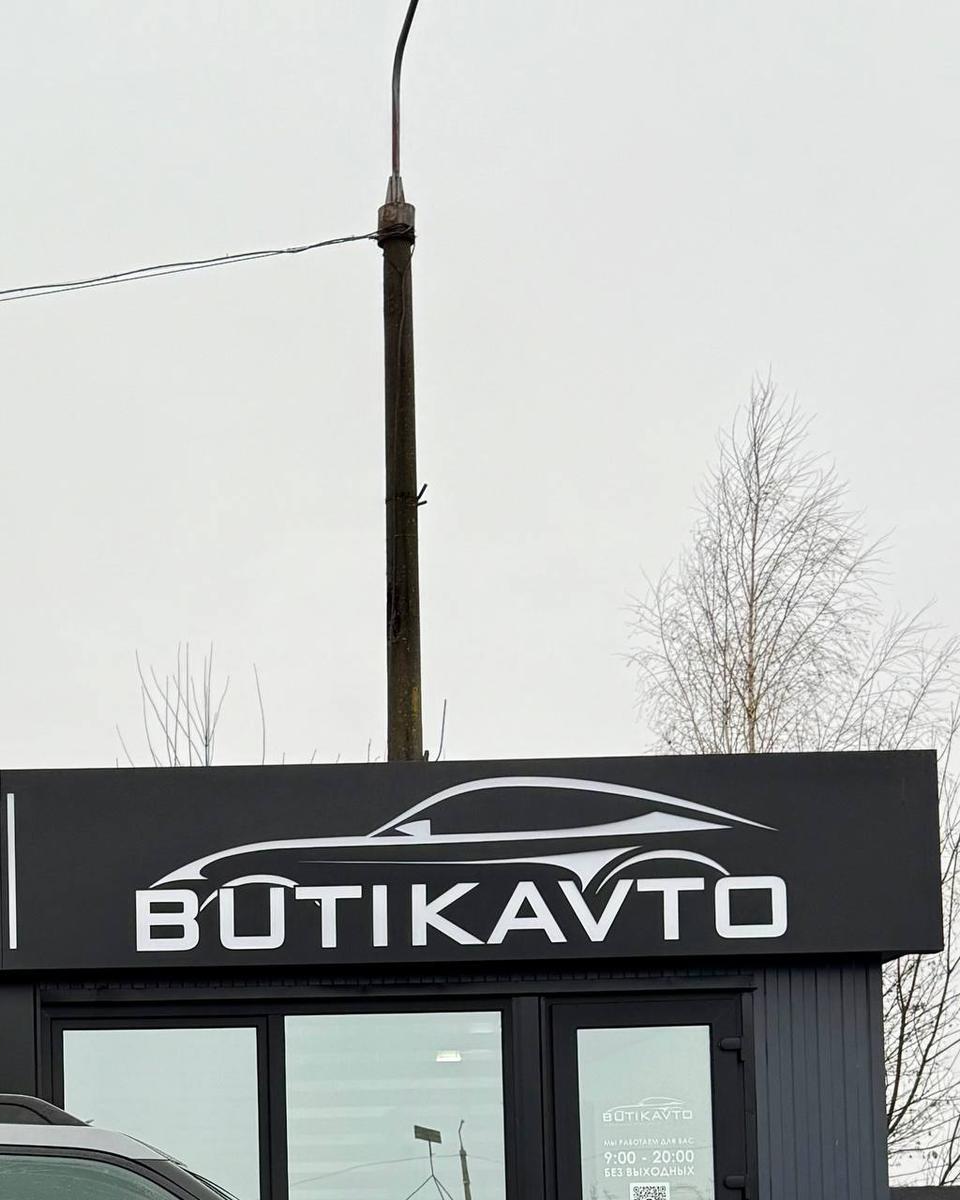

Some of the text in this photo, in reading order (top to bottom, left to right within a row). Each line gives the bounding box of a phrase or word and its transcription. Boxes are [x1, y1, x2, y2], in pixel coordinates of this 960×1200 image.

[135, 875, 788, 953] BUTIKAVTO
[603, 1110, 693, 1122] BUTIKAVTO
[604, 1151, 636, 1164] 9:00
[652, 1150, 694, 1164] 20:00
[604, 1166, 695, 1177] БЕЗ ВЫХОДНЫХ
